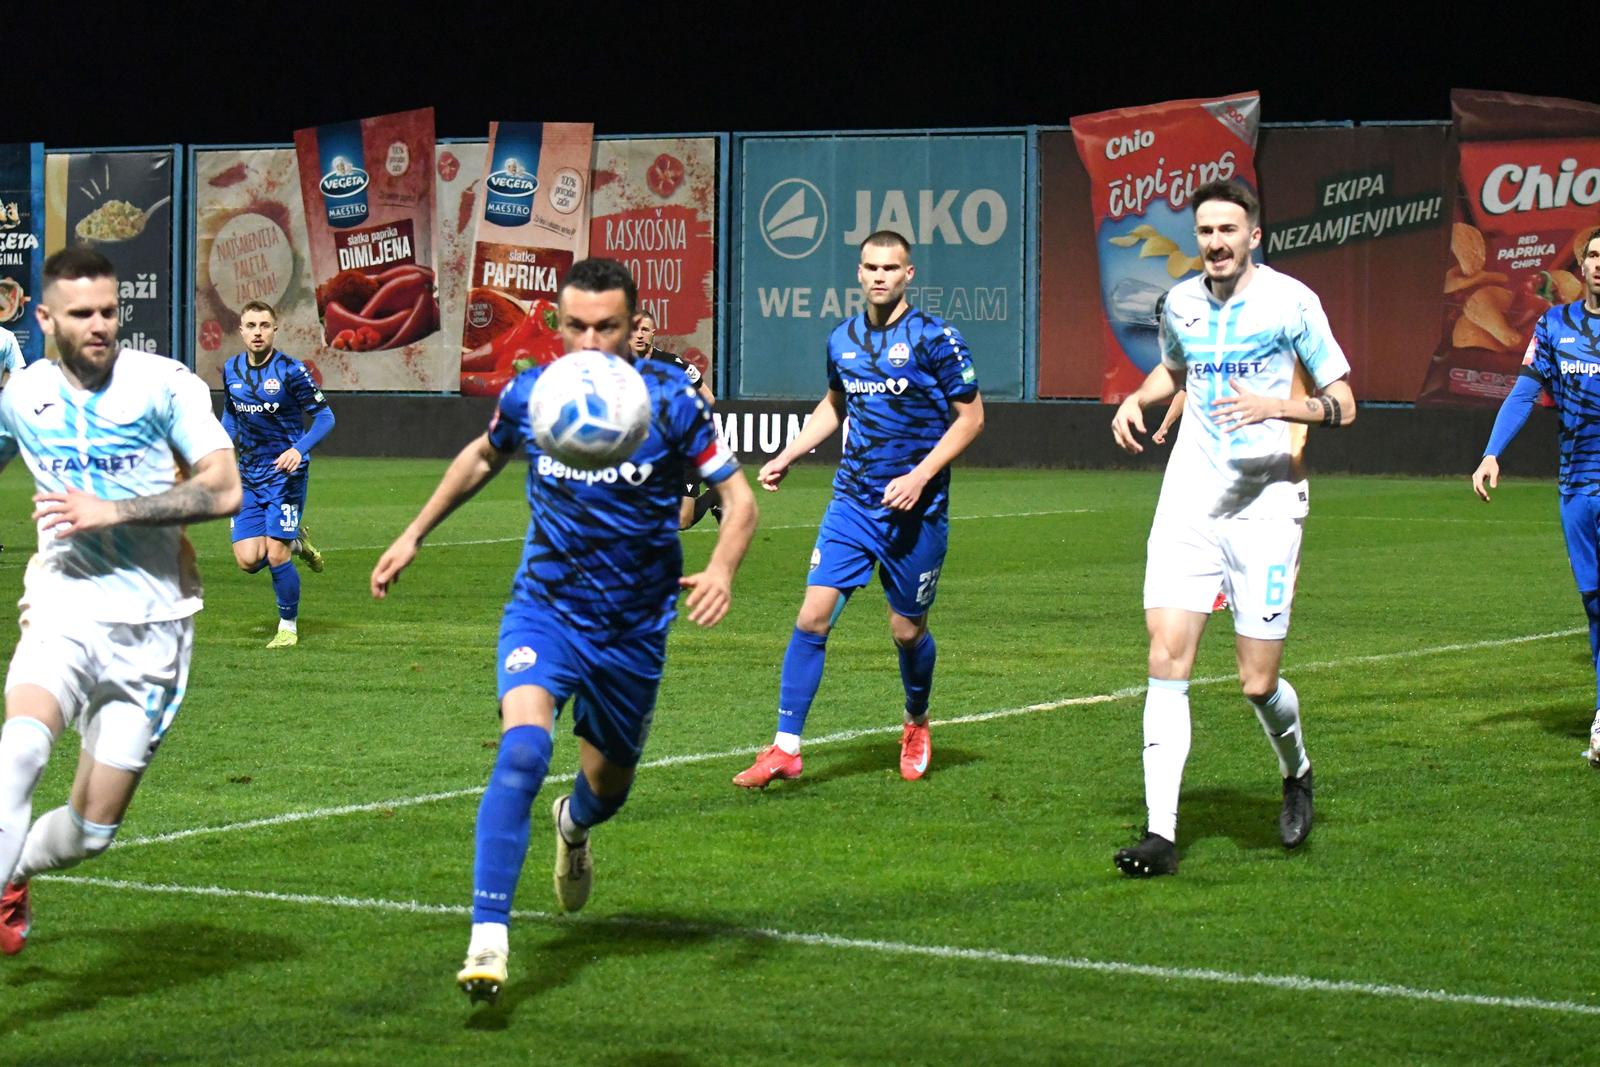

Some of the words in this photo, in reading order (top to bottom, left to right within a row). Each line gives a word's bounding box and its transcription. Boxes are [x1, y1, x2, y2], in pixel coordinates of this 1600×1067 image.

[1105, 129, 1155, 160] Chio
[324, 175, 364, 189] VEGETA
[491, 176, 534, 190] VEGETA
[1323, 174, 1385, 207] EKIPA
[329, 204, 367, 217] MAESTRO
[487, 203, 530, 215] MAESTRO
[844, 189, 1008, 246] JAKO
[347, 232, 370, 246] slatka
[371, 226, 398, 243] paprika
[606, 208, 687, 250] RASKOŠNA
[1267, 197, 1442, 254] NEZAMJENJIVIH!
[1497, 243, 1556, 260] PAPRIKA
[1518, 235, 1538, 245] RED
[339, 235, 412, 271] DIMLJENA
[509, 248, 536, 264] slatka
[1511, 258, 1542, 270] CHIPS
[116, 273, 157, 299] aži
[482, 261, 558, 293] PAPRIKA
[646, 258, 682, 294] TVOJ
[117, 300, 134, 327] je
[758, 287, 811, 318] WE
[820, 287, 864, 318] AR
[1194, 362, 1262, 375] FAVBET
[52, 454, 139, 472] FAVBET
[280, 503, 299, 527] 33
[1265, 564, 1287, 606] 6
[474, 889, 507, 900] JAKO
